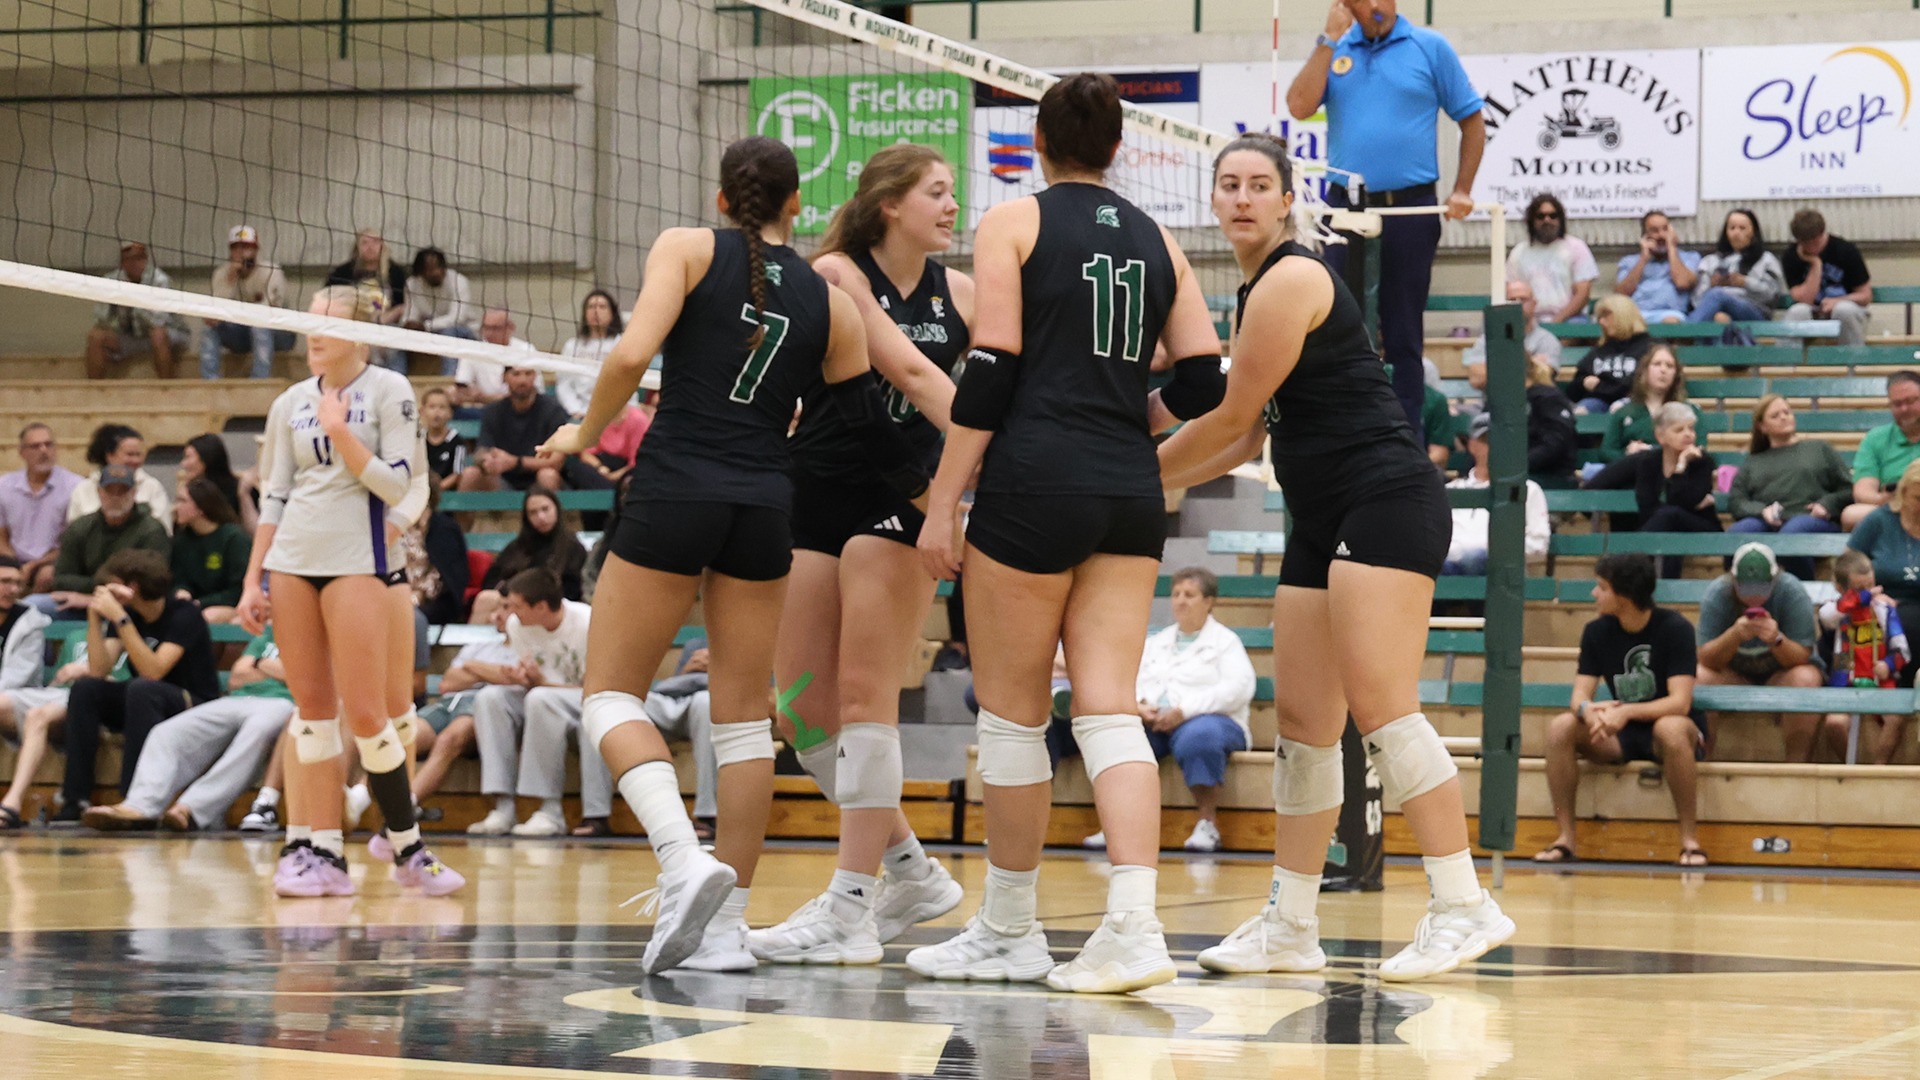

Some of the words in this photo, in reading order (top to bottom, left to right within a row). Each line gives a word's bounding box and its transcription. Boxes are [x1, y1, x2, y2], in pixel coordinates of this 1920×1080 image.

[848, 117, 960, 137] Insurance
[849, 81, 960, 113] Ficken
[1484, 56, 1693, 144] MATTHEWS
[1743, 74, 1894, 160] Sleep
[1801, 151, 1846, 169] INN
[1082, 253, 1145, 362] 11
[729, 302, 790, 404] 7
